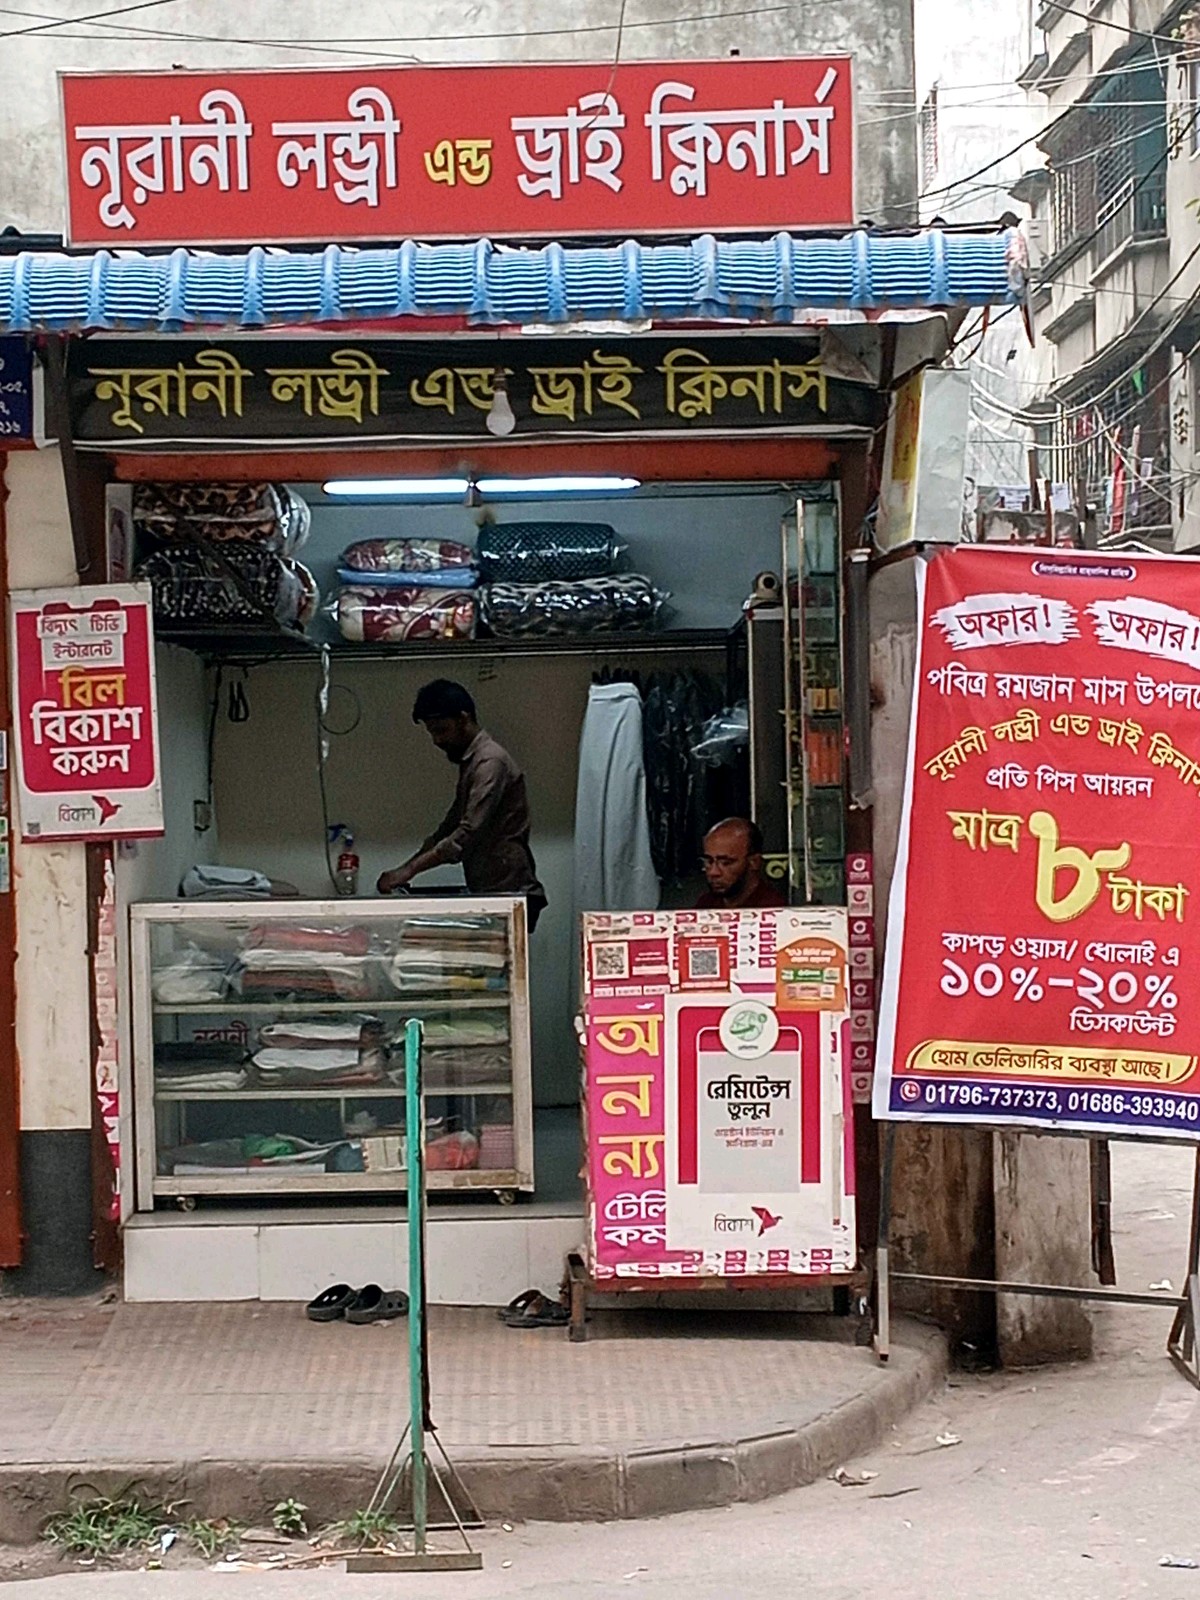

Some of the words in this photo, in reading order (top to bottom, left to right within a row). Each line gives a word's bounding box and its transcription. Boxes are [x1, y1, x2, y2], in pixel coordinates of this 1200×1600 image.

[75, 89, 252, 230] নূরানী
[272, 87, 402, 206] লন্ড্রী
[423, 139, 493, 187] এন্ড
[511, 94, 625, 200] ড্রাই
[644, 67, 838, 197] ক্লিনার্স
[87, 348, 255, 434] নূরানী
[266, 349, 391, 424] লন্ড্রী
[526, 348, 643, 423] ড্রাই
[41, 616, 78, 637] বিদ্যুৎ
[90, 614, 121, 632] টিভি
[955, 603, 1052, 639] অফার!
[53, 639, 114, 659] ইন্টারনেট
[58, 665, 127, 708] বিল
[926, 661, 988, 698] পবিত্র
[993, 672, 1075, 704] রমজান
[1081, 676, 1129, 707] মাস
[29, 700, 143, 745] বিকাশ
[49, 744, 131, 776] করুন
[923, 725, 989, 782] নূরানী
[990, 707, 1042, 743] লন্ড্রী
[1097, 717, 1145, 755] ড্রাই
[985, 762, 1030, 791] প্রতি
[1034, 763, 1077, 793] পিস
[1081, 772, 1154, 798] আয়রন
[946, 808, 1025, 853] মাত্র
[1028, 811, 1132, 923] ৮
[1105, 872, 1190, 923] টাকা
[942, 931, 1006, 959] কাপড়
[1085, 940, 1157, 966] ধোলাই
[1161, 946, 1180, 966] এ
[1069, 1006, 1178, 1036] ডিসকাউন্ট
[931, 1049, 967, 1066] হোম
[972, 1046, 1063, 1070] ডেলিভারির
[1068, 1055, 1117, 1074] ব্যবস্থা
[707, 1074, 791, 1099] রেমিটেন্স
[925, 1083, 1063, 1112] 01796-737373,
[1068, 1091, 1199, 1120] 01686-393940
[727, 1102, 771, 1120] তুলুন
[714, 1213, 754, 1233] বিকাশ
